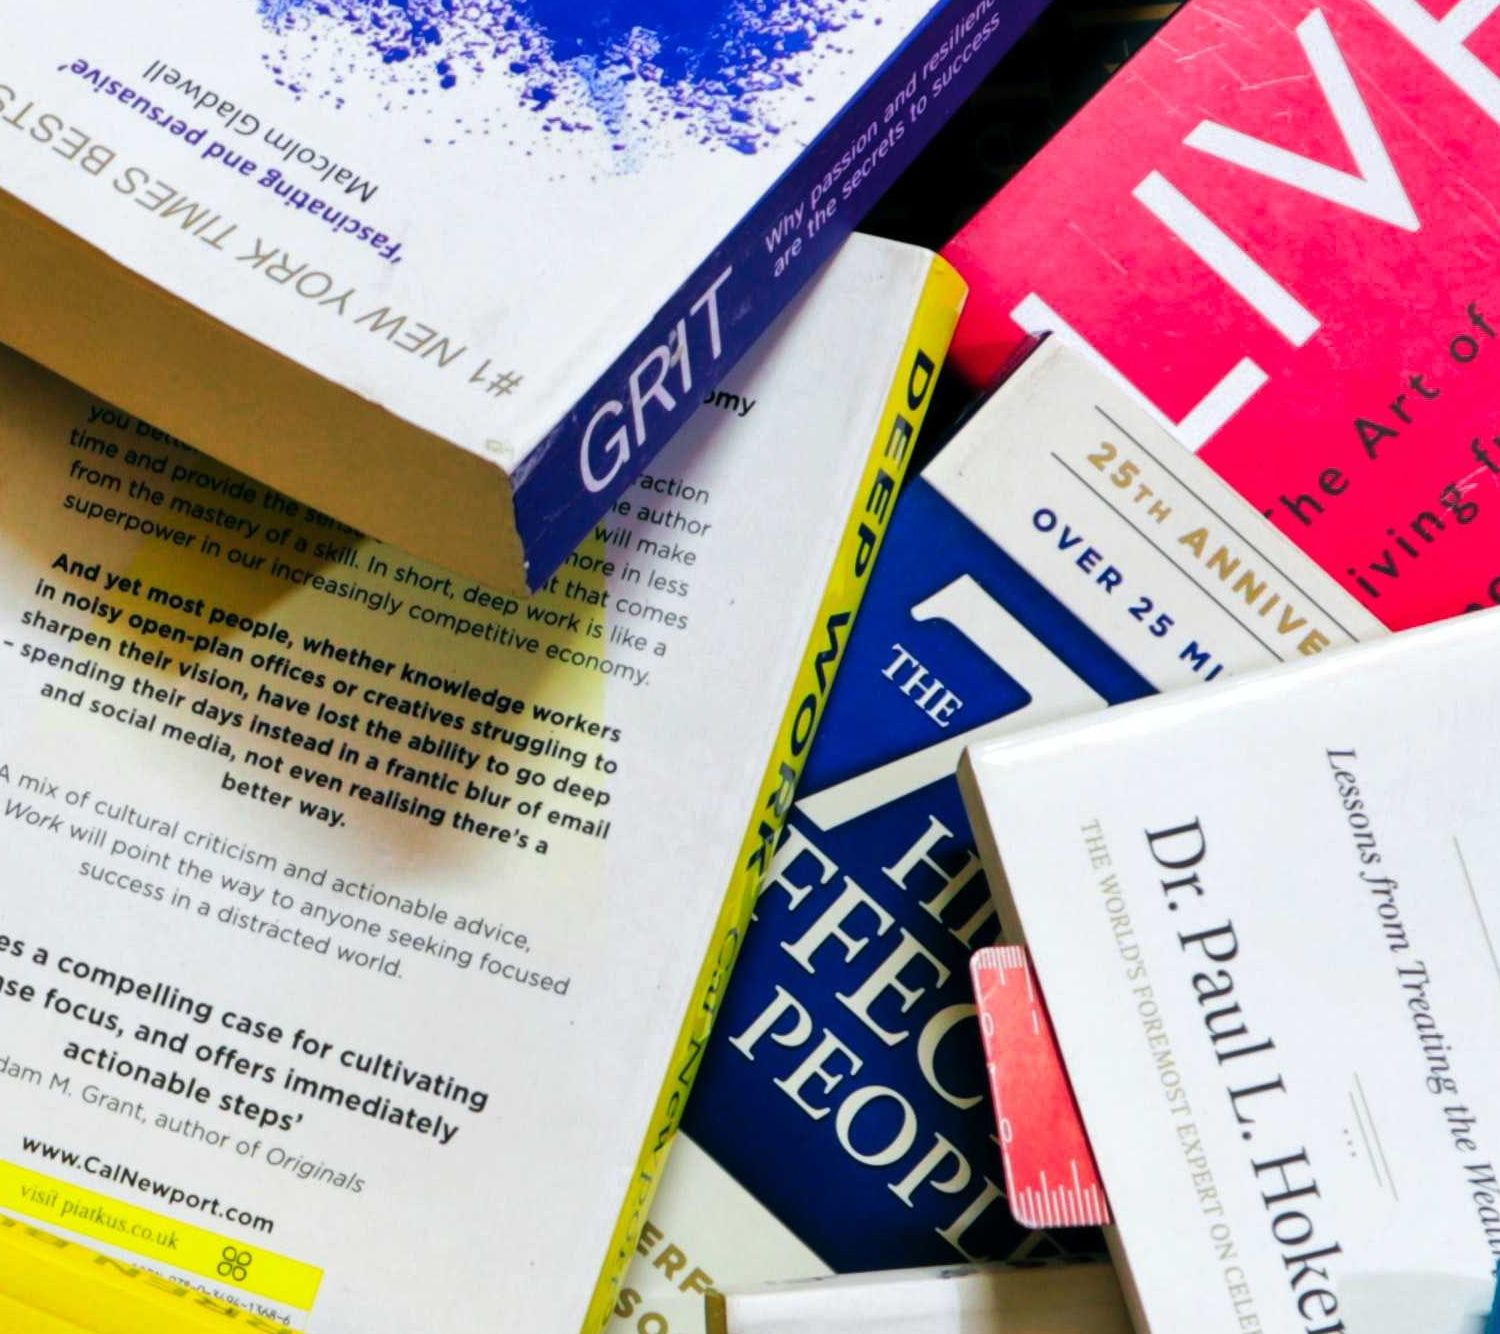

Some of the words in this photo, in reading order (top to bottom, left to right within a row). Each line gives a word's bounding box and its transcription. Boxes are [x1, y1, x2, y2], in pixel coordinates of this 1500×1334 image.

[141, 59, 260, 136] Gladwell
[262, 127, 378, 200] Malcolm
[574, 266, 743, 494] GRIT
[1032, 506, 1123, 600] OVER
[1126, 593, 1179, 644] 25
[1144, 817, 1206, 911] Dr.
[1177, 920, 1270, 1064] Paul
[1227, 1078, 1282, 1140] L.
[62, 1041, 211, 1104] actionable
[22, 1136, 274, 1234] www.CalNewport.com
